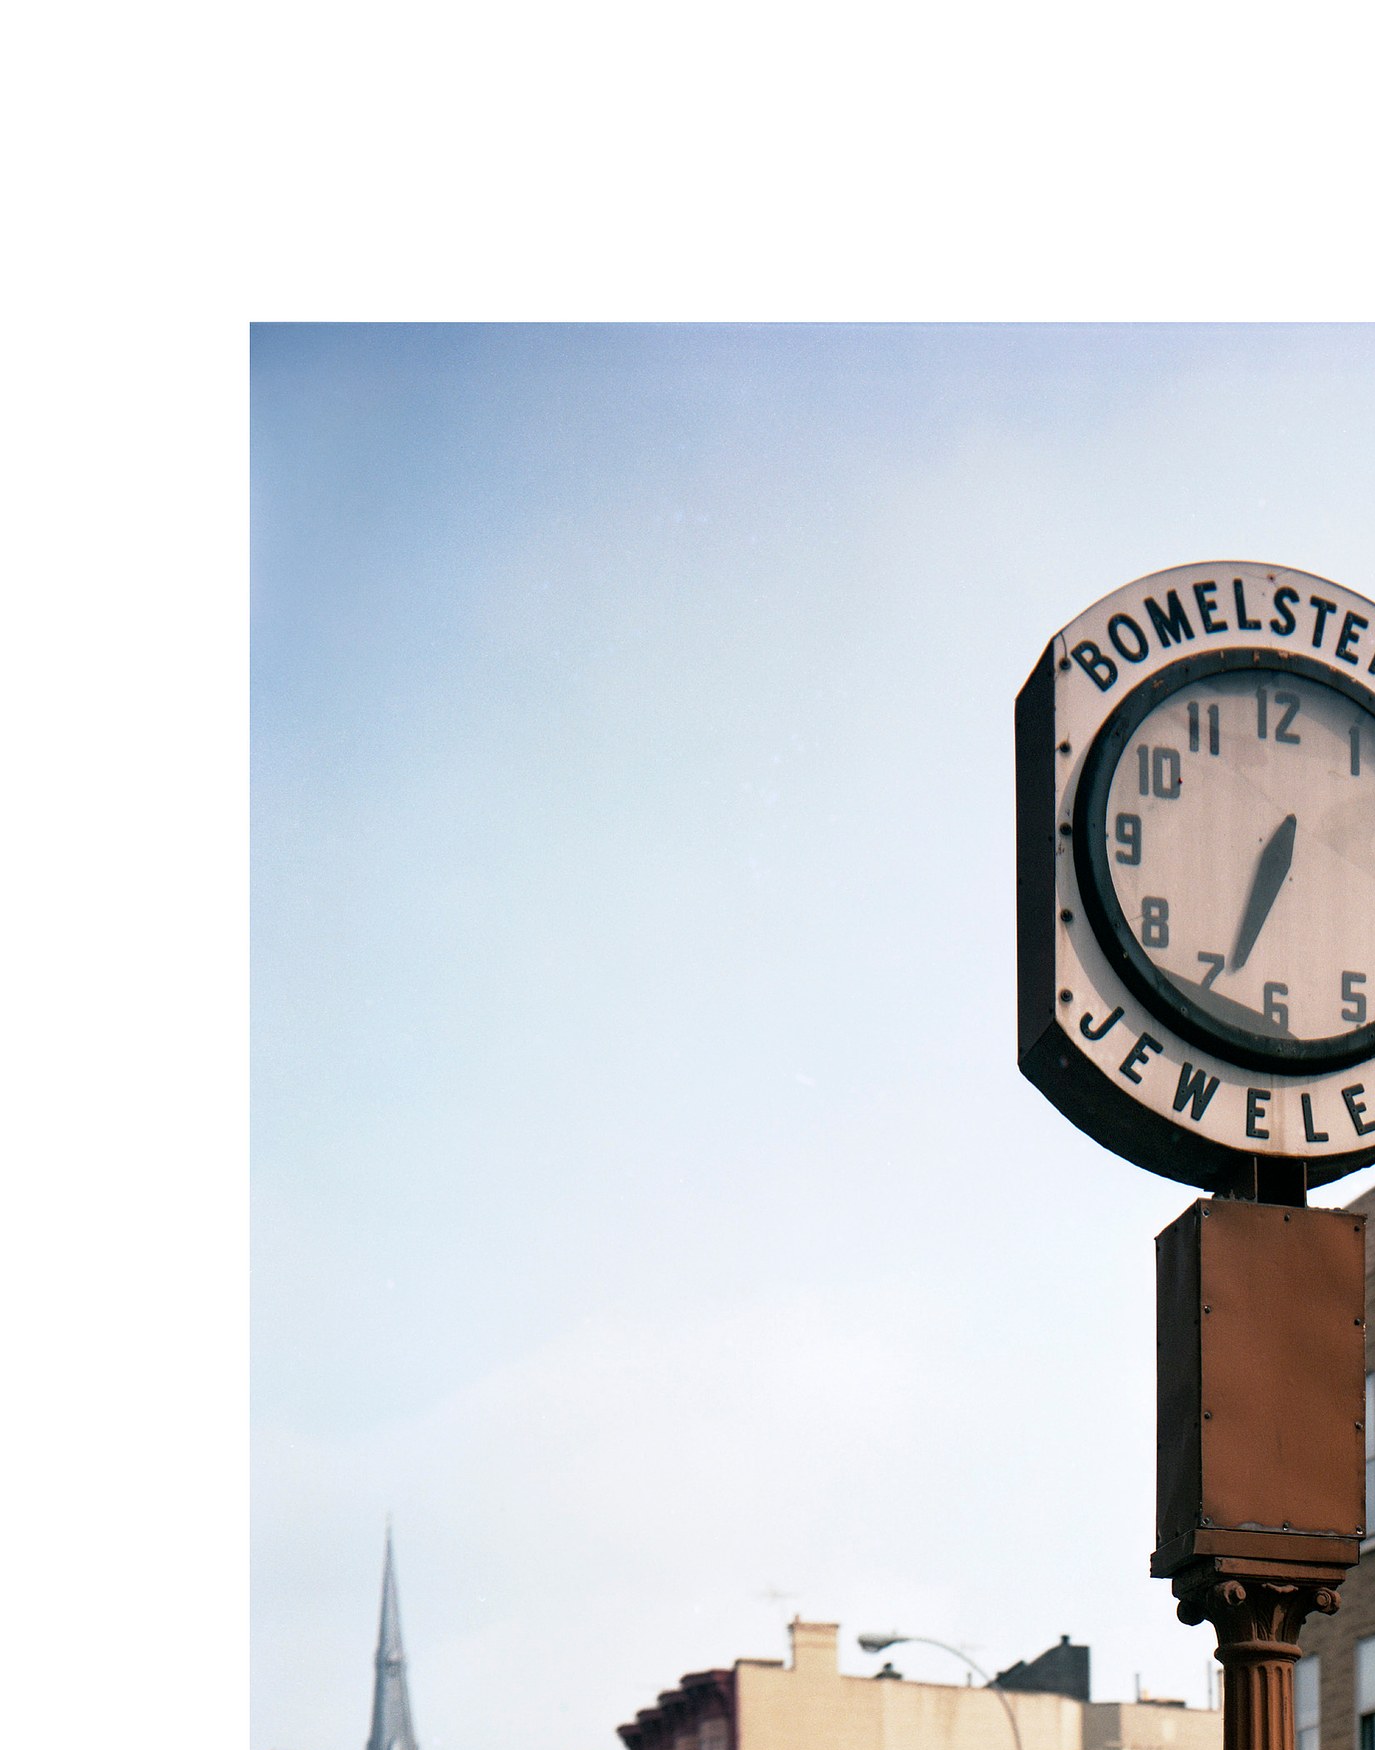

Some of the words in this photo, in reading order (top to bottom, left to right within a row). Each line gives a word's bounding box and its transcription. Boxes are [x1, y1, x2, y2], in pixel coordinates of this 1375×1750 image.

[1187, 701, 1221, 756] 11
[1256, 685, 1301, 744] 12
[1136, 744, 1181, 800] 10
[1348, 726, 1361, 777] 1
[1115, 813, 1142, 866] 9
[1141, 896, 1170, 948] 8
[1198, 951, 1226, 992] 7
[1263, 981, 1289, 1033] 6
[1342, 972, 1368, 1024] 5
